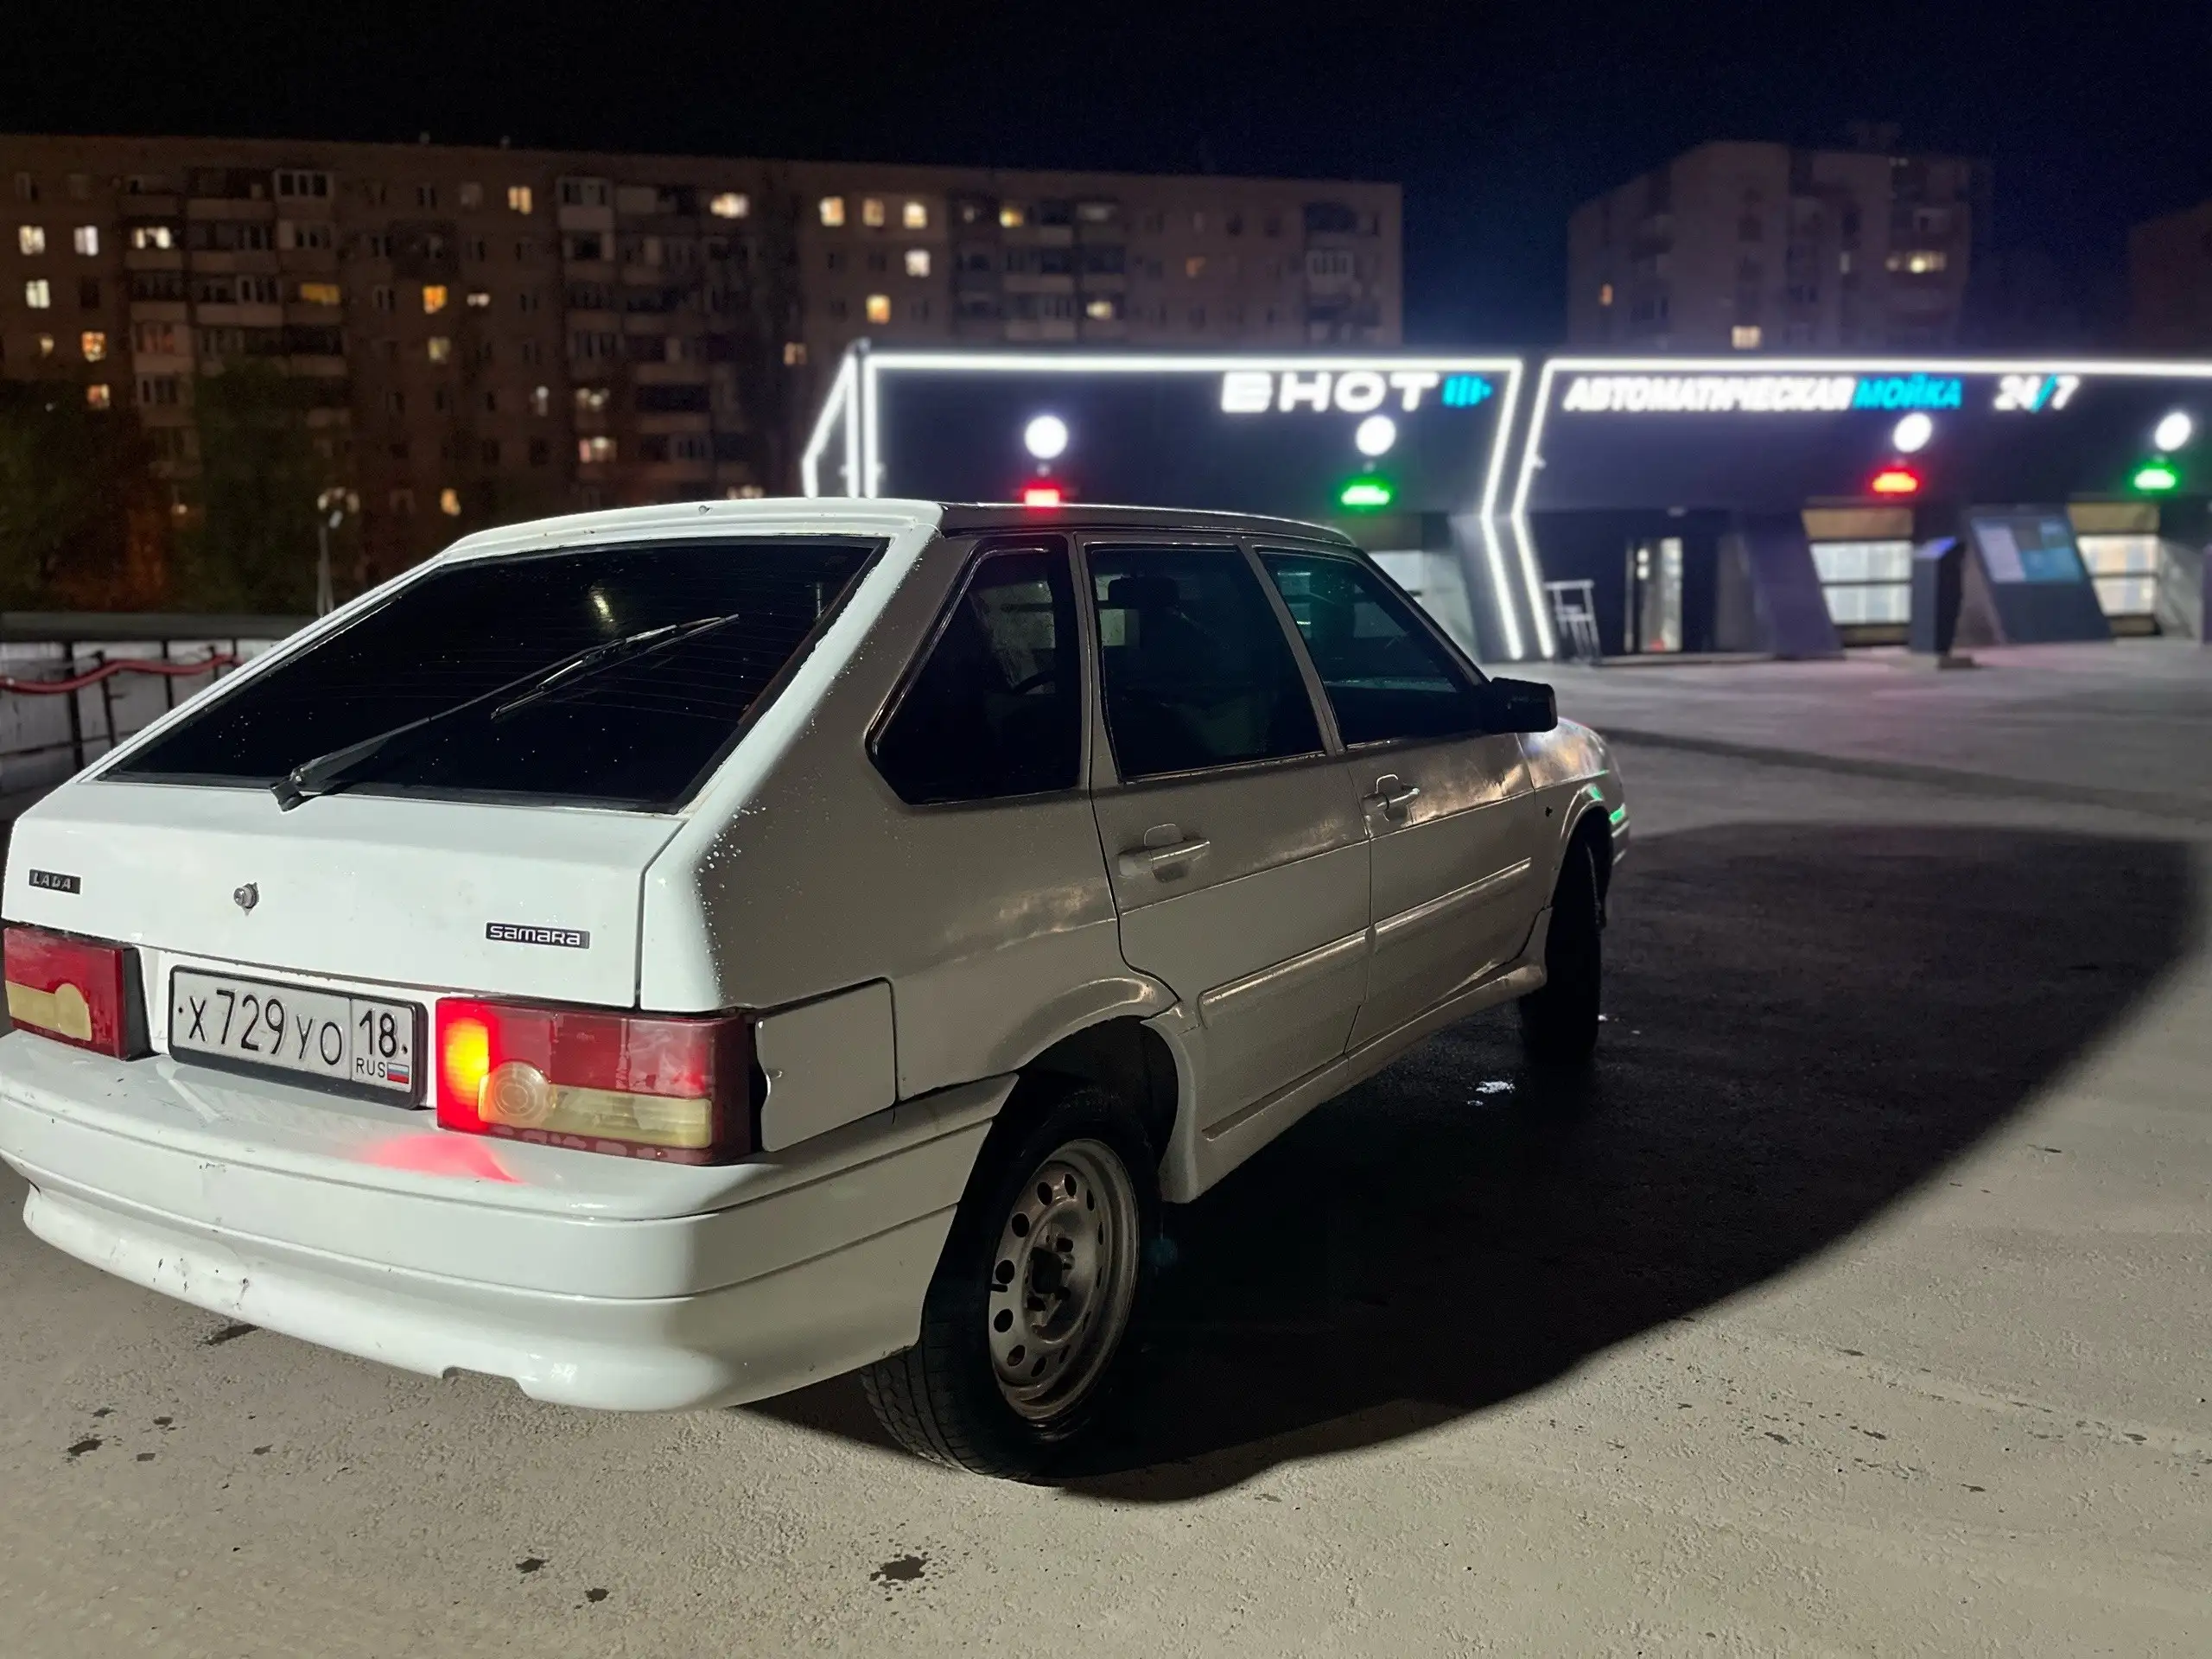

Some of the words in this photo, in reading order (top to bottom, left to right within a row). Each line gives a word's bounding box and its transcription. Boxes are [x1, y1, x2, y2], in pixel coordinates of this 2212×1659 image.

[1853, 372, 1961, 409] МОЙКА
[1993, 373, 2080, 412] 24/7
[33, 872, 71, 889] LADA
[359, 1008, 397, 1058] 18
[356, 1058, 386, 1077] RUS
